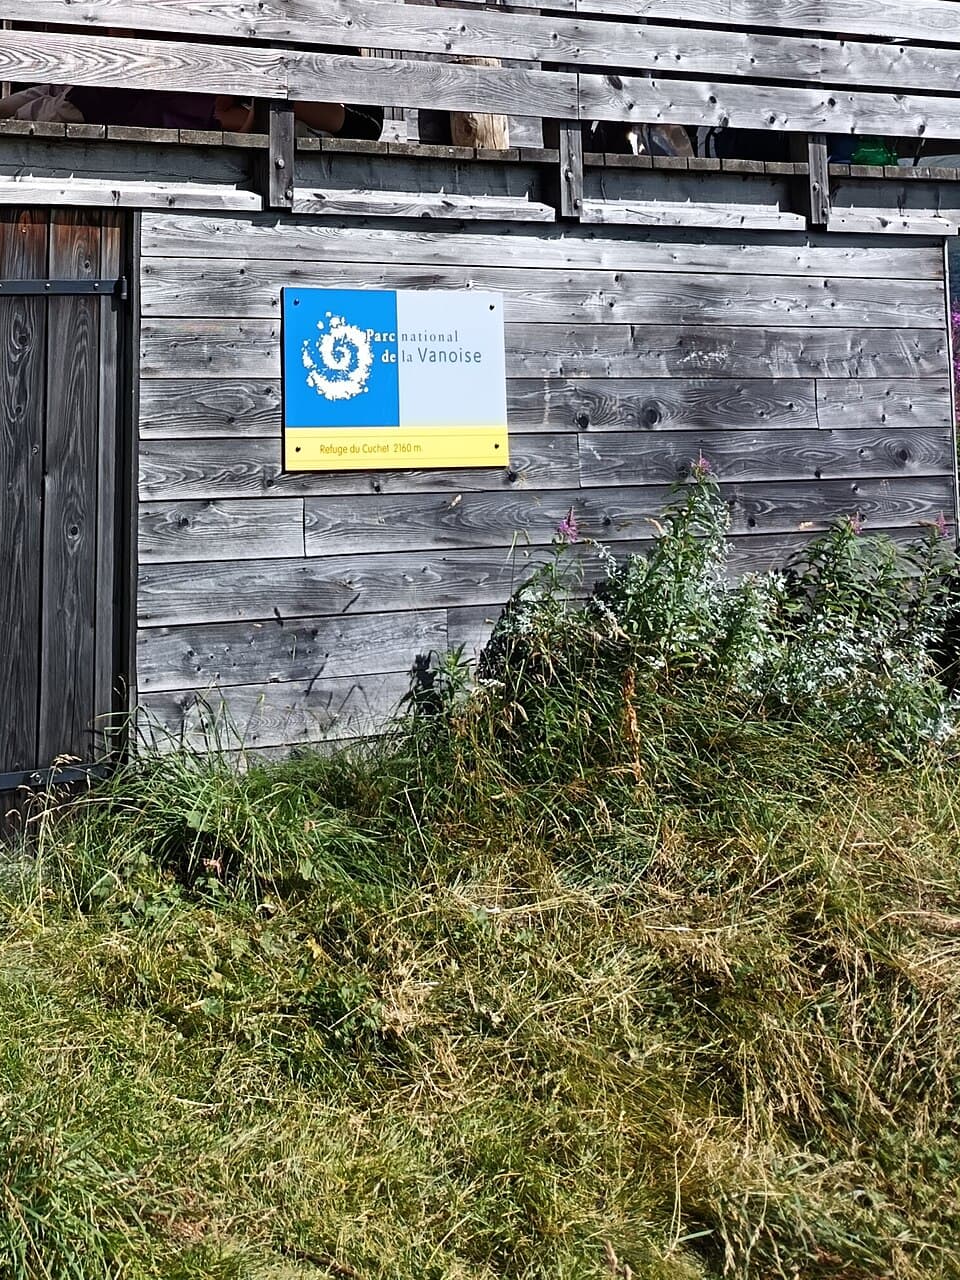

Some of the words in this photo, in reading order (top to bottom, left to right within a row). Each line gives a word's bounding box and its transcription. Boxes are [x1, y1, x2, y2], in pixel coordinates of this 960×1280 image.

[365, 328, 395, 343] Parc
[401, 330, 459, 343] national
[381, 350, 397, 363] de
[401, 350, 413, 363] la
[417, 347, 482, 363] Vanoise
[320, 444, 348, 456] Refuge
[350, 444, 360, 454] du
[362, 444, 389, 454] Cuchet
[393, 443, 411, 453] 2160
